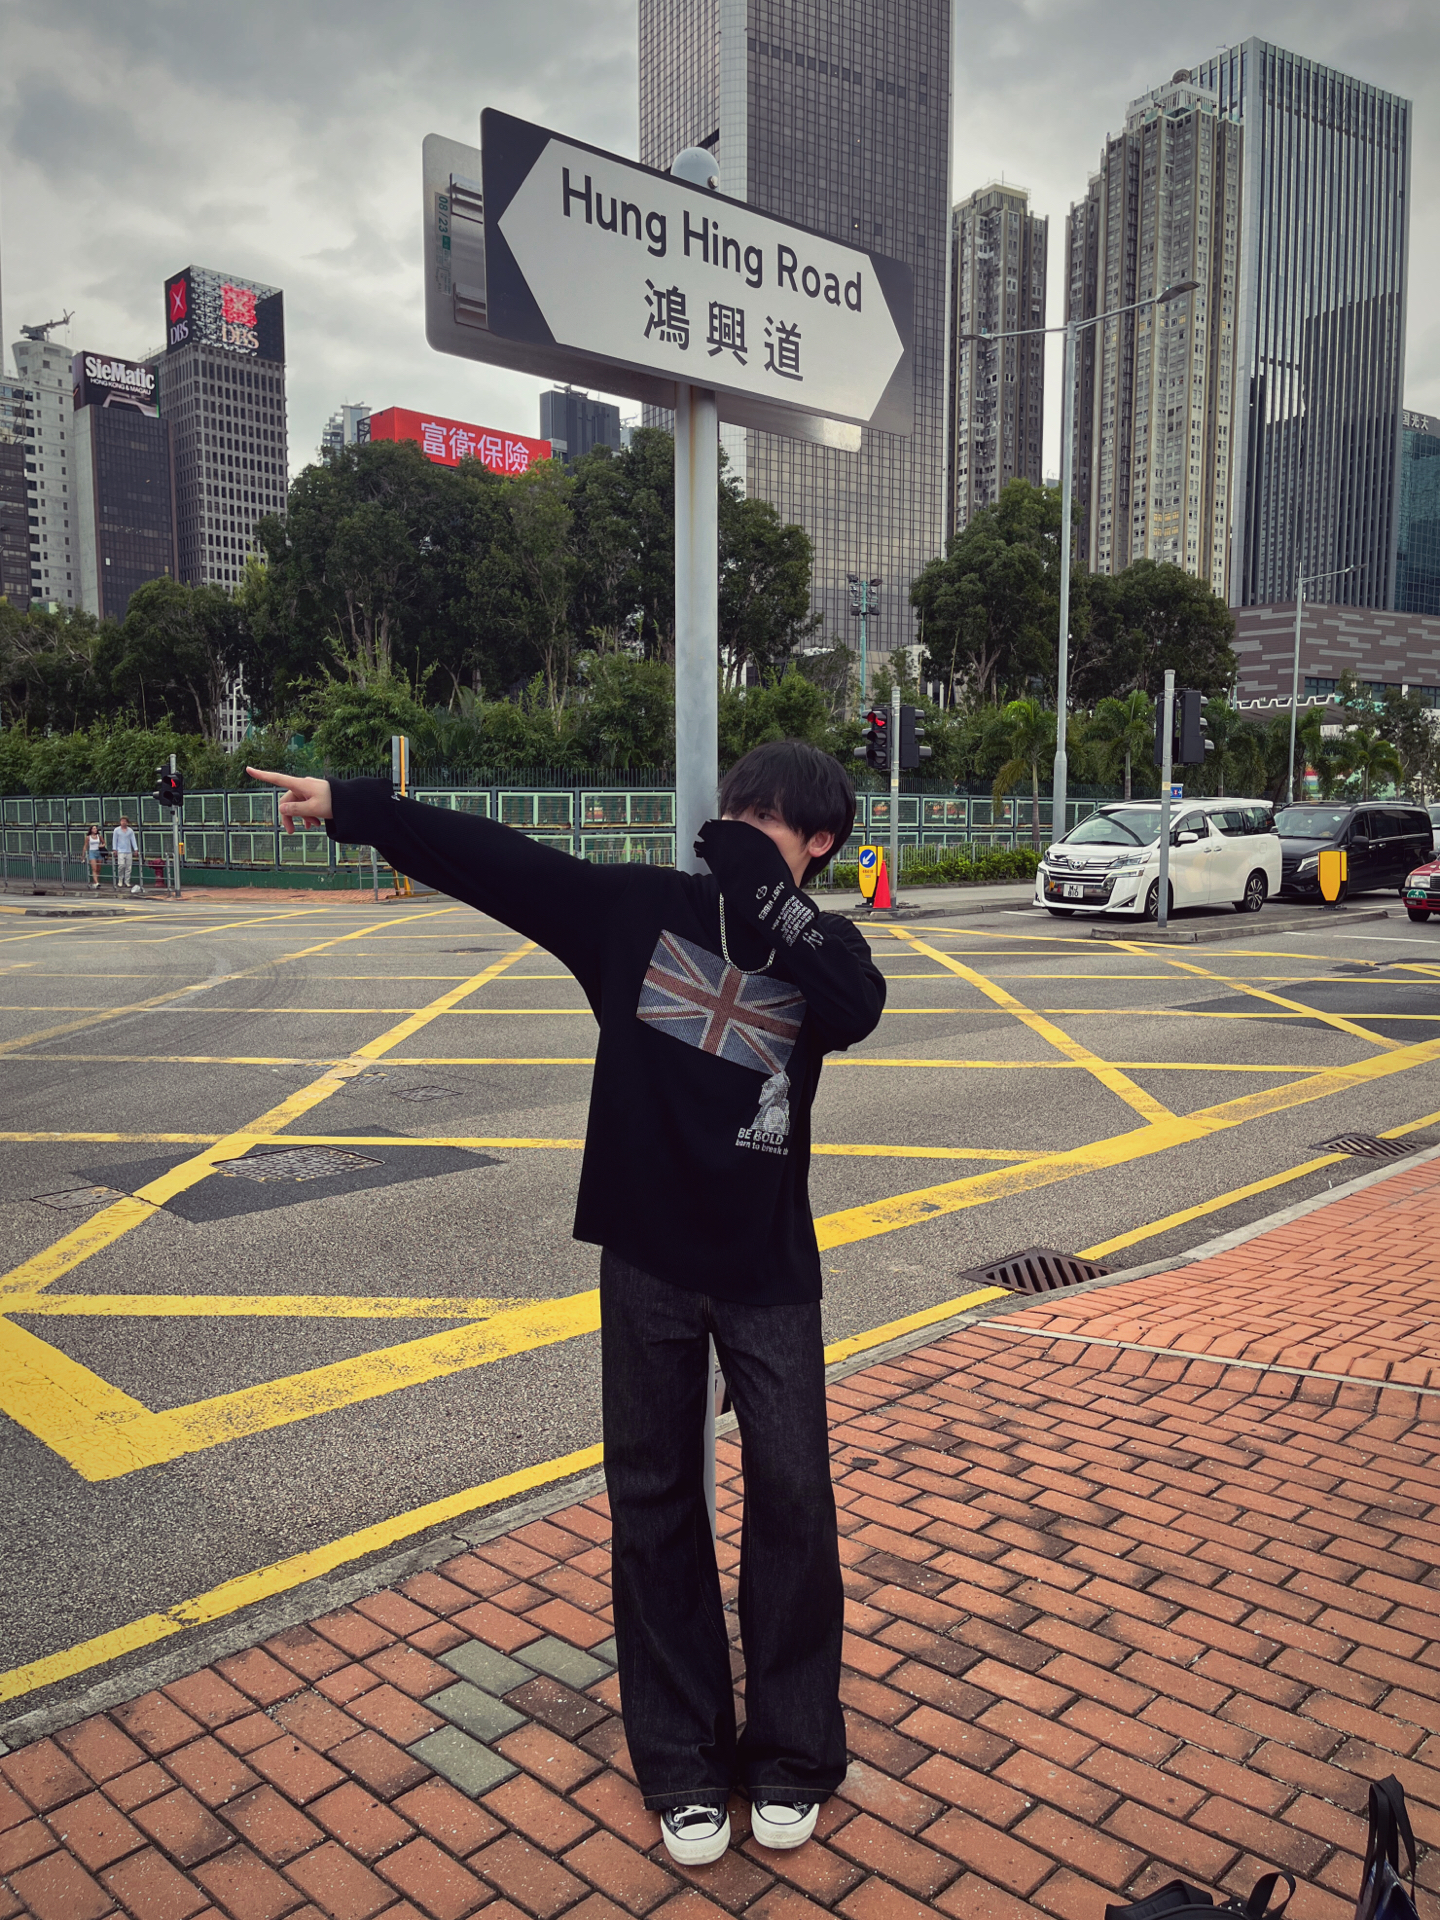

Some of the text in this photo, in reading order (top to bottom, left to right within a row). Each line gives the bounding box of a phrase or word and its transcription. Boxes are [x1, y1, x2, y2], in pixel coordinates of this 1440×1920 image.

[438, 195, 449, 234] 08/23
[562, 167, 862, 313] Hung Hing Road
[170, 320, 189, 345] DBS
[221, 323, 260, 349] DBS
[643, 278, 804, 382] 鴻興道
[85, 356, 155, 390] SieMatic
[90, 378, 108, 387] HONG
[108, 380, 125, 391] KONG
[130, 385, 151, 396] MACAU
[421, 421, 530, 474] 富衛保險
[758, 881, 785, 920] JUST VIBES
[735, 1138, 751, 1149] born
[752, 1142, 760, 1150] to
[761, 1143, 782, 1155] break
[737, 1127, 784, 1146] BE BOLD
